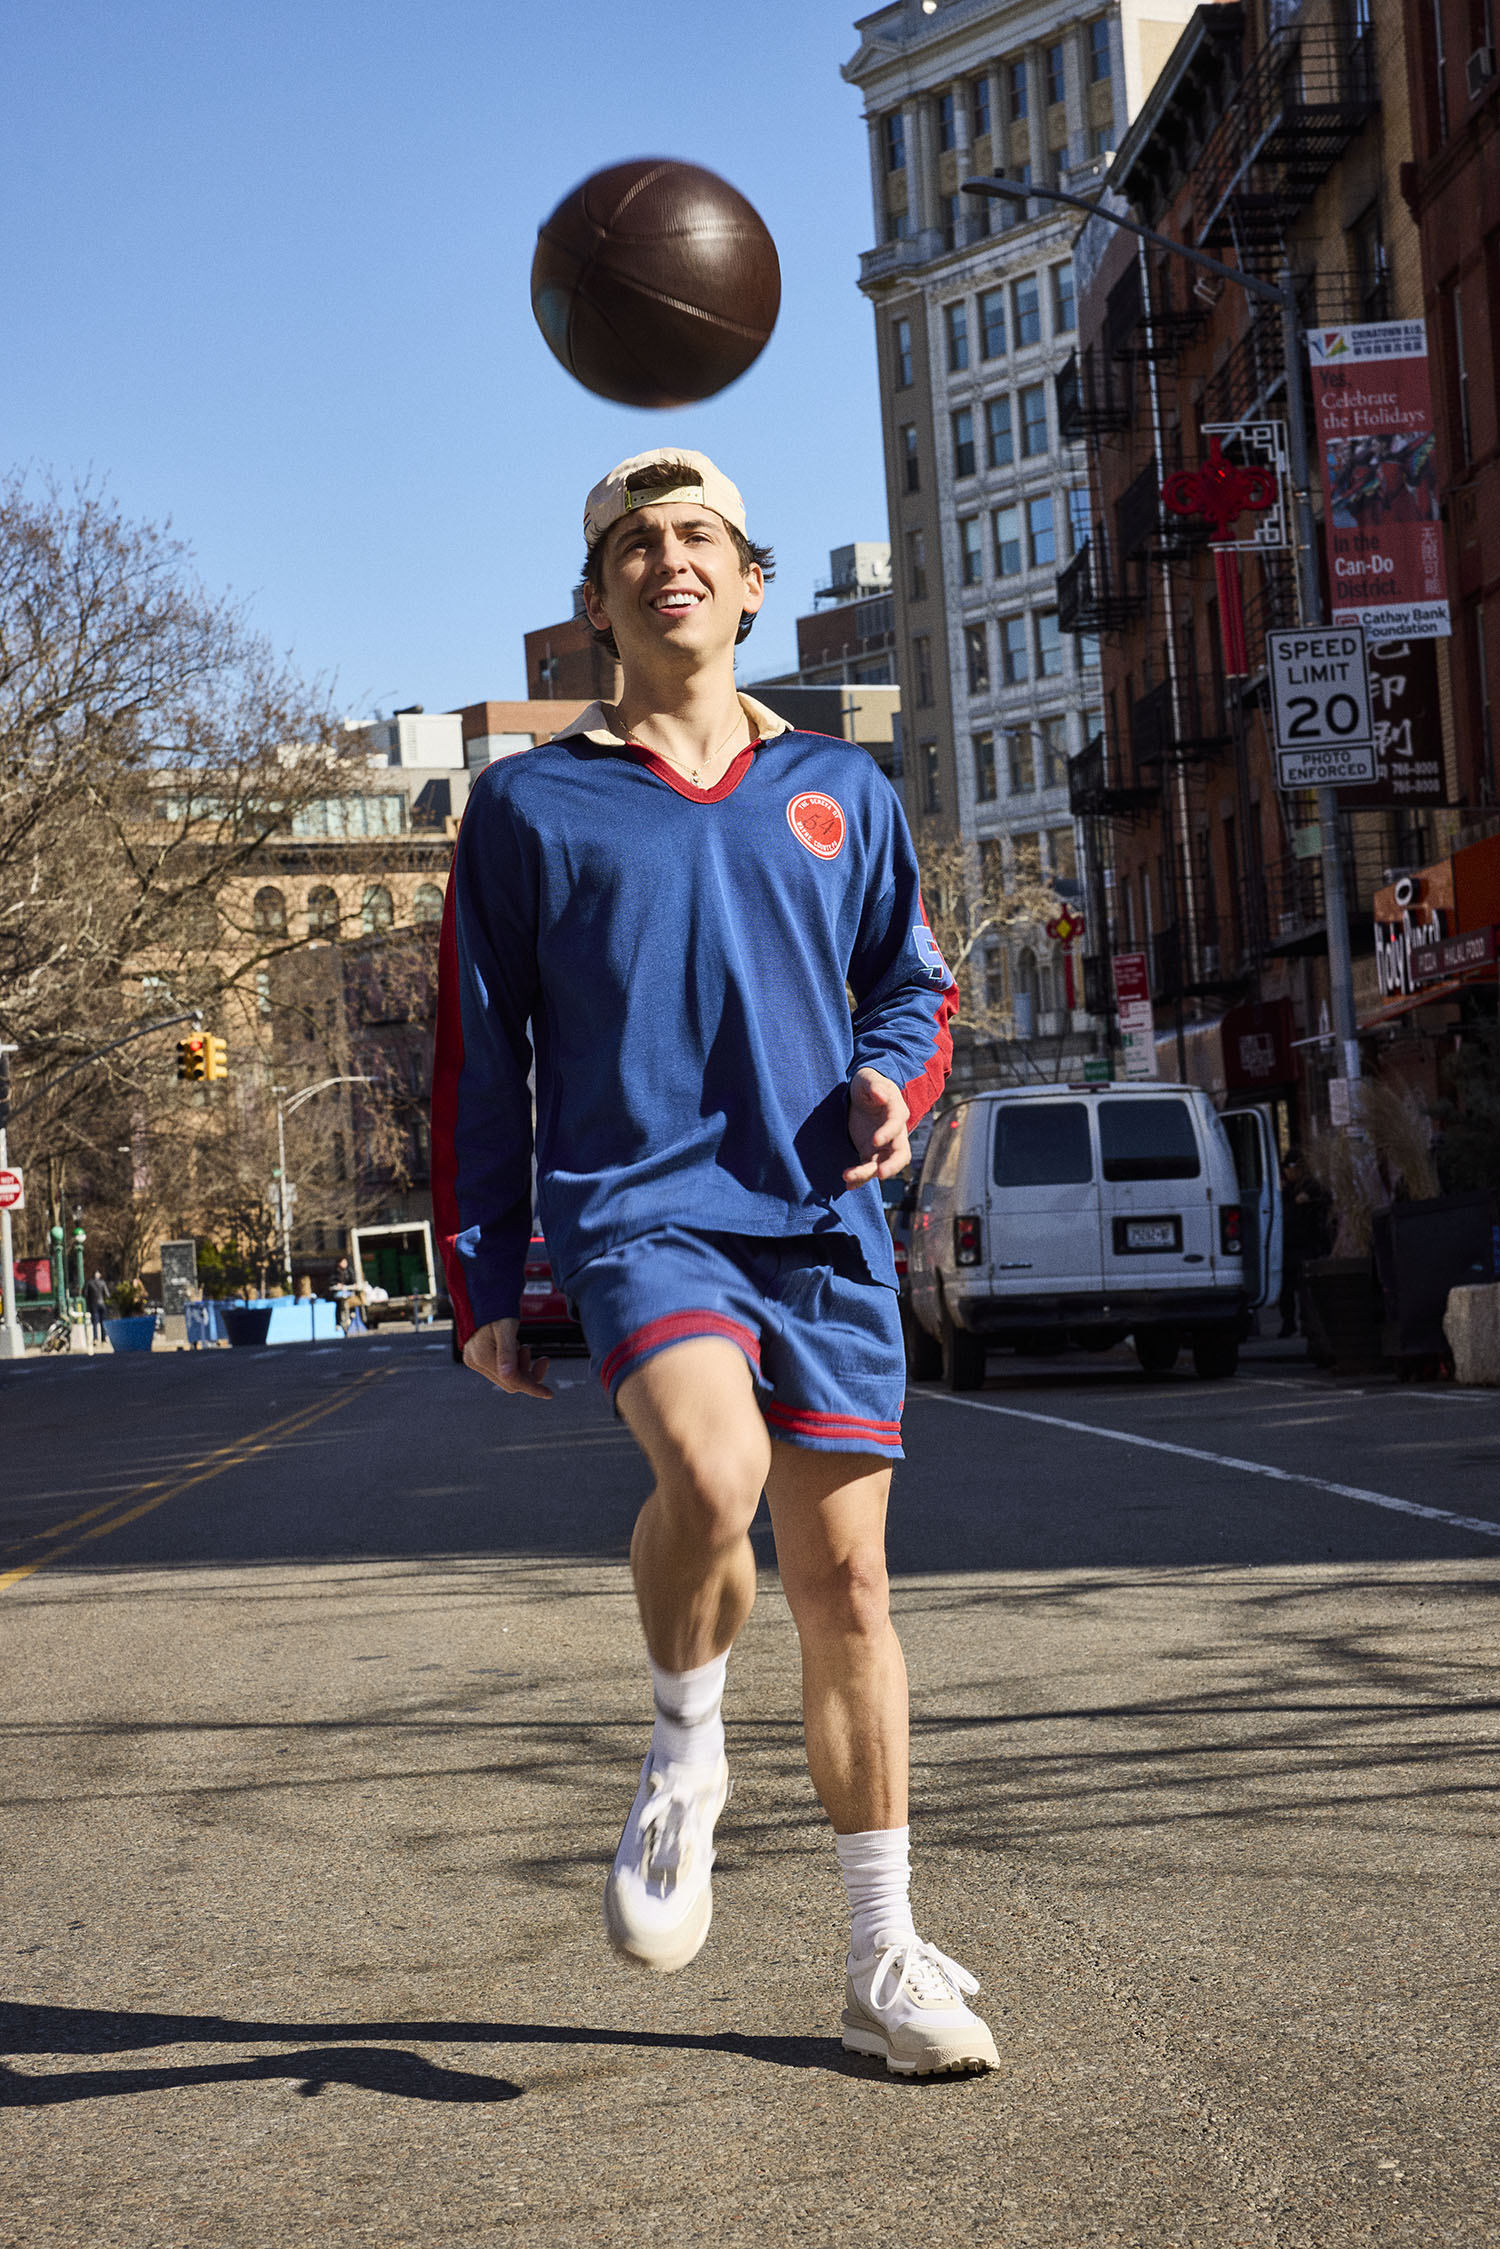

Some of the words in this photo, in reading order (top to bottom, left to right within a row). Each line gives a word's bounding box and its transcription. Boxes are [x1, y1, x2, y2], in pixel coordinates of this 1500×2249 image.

[1320, 389, 1398, 409] Celebrate
[1323, 412, 1349, 429] the
[1353, 406, 1426, 428] Holidays
[1333, 536, 1349, 553] In
[1354, 535, 1380, 551] the
[1335, 554, 1394, 577] Can-Do
[1337, 578, 1401, 599] District.
[1362, 610, 1410, 627] Cathay
[1413, 608, 1447, 621] Bank
[1279, 638, 1356, 660] SPEED
[1288, 663, 1349, 684] LIMIT
[1286, 694, 1358, 738] 20
[1302, 751, 1351, 765] PHOTO
[1288, 764, 1367, 781] ENFORCED
